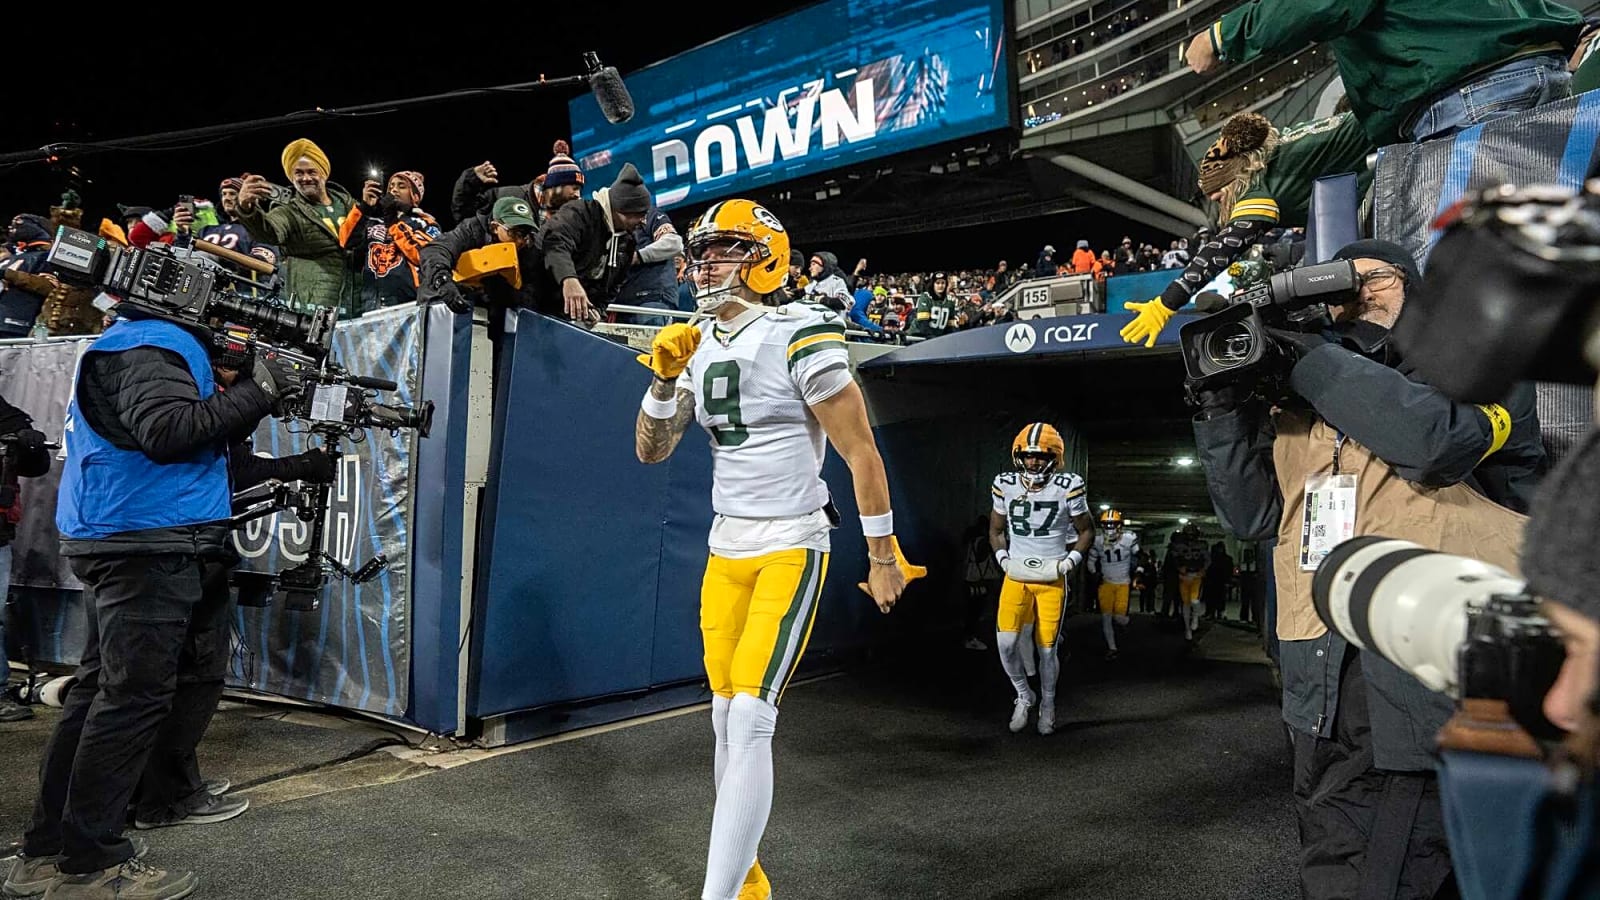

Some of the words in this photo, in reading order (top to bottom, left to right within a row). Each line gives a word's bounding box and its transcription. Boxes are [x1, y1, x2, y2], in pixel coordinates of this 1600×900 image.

[652, 79, 876, 207] DOWN
[1025, 289, 1047, 304] 155
[930, 306, 950, 329] 90
[1045, 322, 1099, 343] razr
[703, 360, 750, 446] 9
[1009, 499, 1059, 536] 87
[1105, 548, 1122, 563] 11
